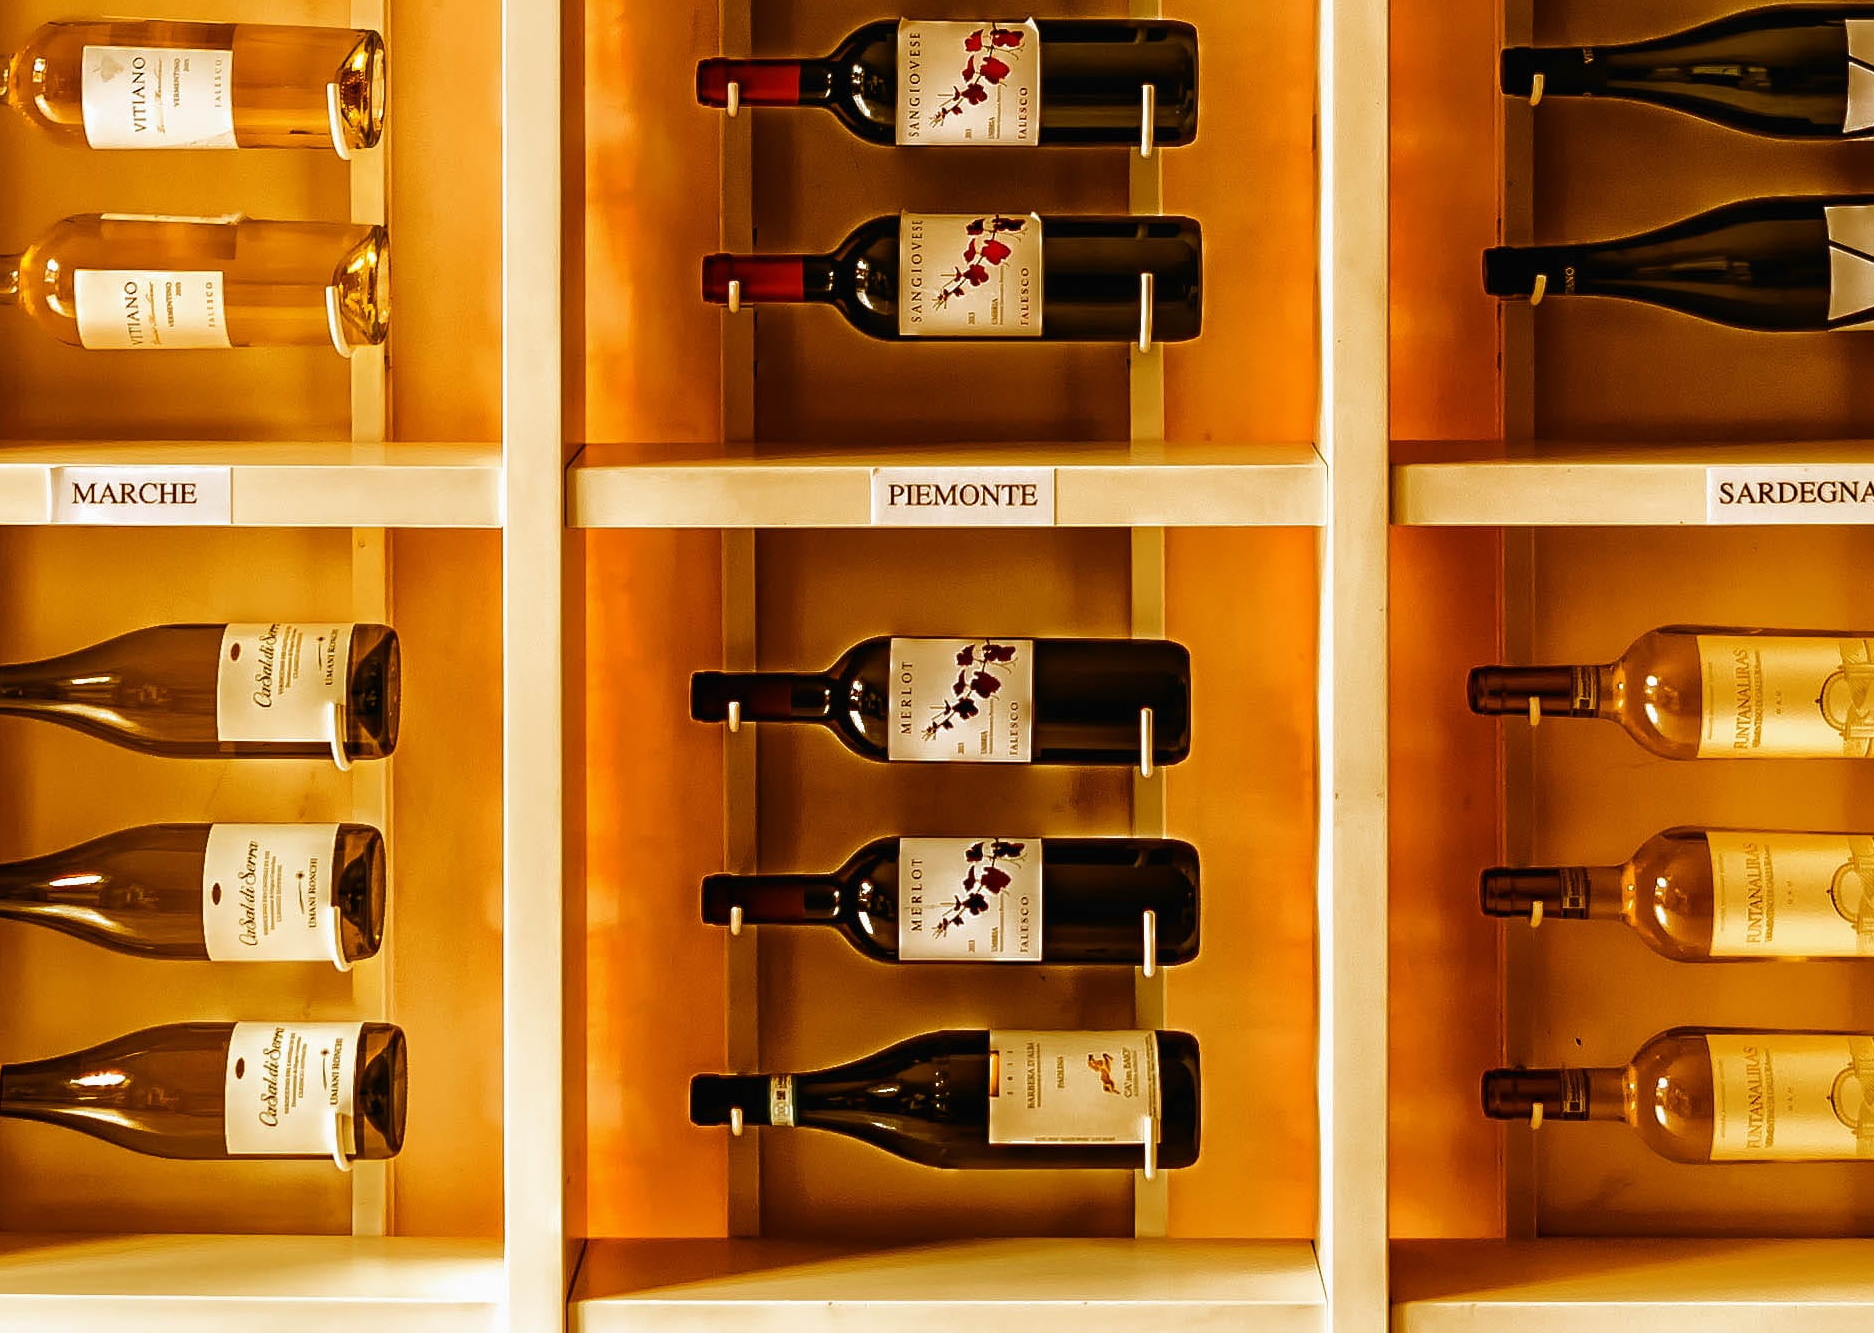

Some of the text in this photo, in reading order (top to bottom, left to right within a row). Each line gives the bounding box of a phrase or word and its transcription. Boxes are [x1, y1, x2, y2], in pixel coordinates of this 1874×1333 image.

[132, 57, 147, 133] VITIANO
[173, 58, 181, 107] VERMENTINO
[214, 59, 223, 108] FALESCO
[909, 32, 921, 137] SANGIOVESE
[1017, 87, 1028, 140] FALESCO
[910, 220, 923, 323] SANGIOVESE
[1020, 268, 1029, 326] FALESCO
[125, 281, 143, 345] VITIANO
[206, 281, 215, 328] FALESCO
[71, 482, 198, 504] MARCHE
[887, 483, 1038, 506] PIEMONTE
[325, 654, 336, 686] UMANI
[900, 661, 913, 735] MERLOT
[1734, 650, 1752, 749] FUNTANALIRAS
[1009, 702, 1019, 755] FALESCO
[307, 858, 318, 928] UMANI RONCHI
[910, 859, 923, 932] MERLOT
[1743, 843, 1762, 944] FUNTANALIRAS
[1019, 897, 1030, 953] FALESCO
[329, 1072, 340, 1106] UMANI
[1026, 1067, 1035, 1109] BARBERA
[1742, 1046, 1764, 1149] FUNTANALIRAS
